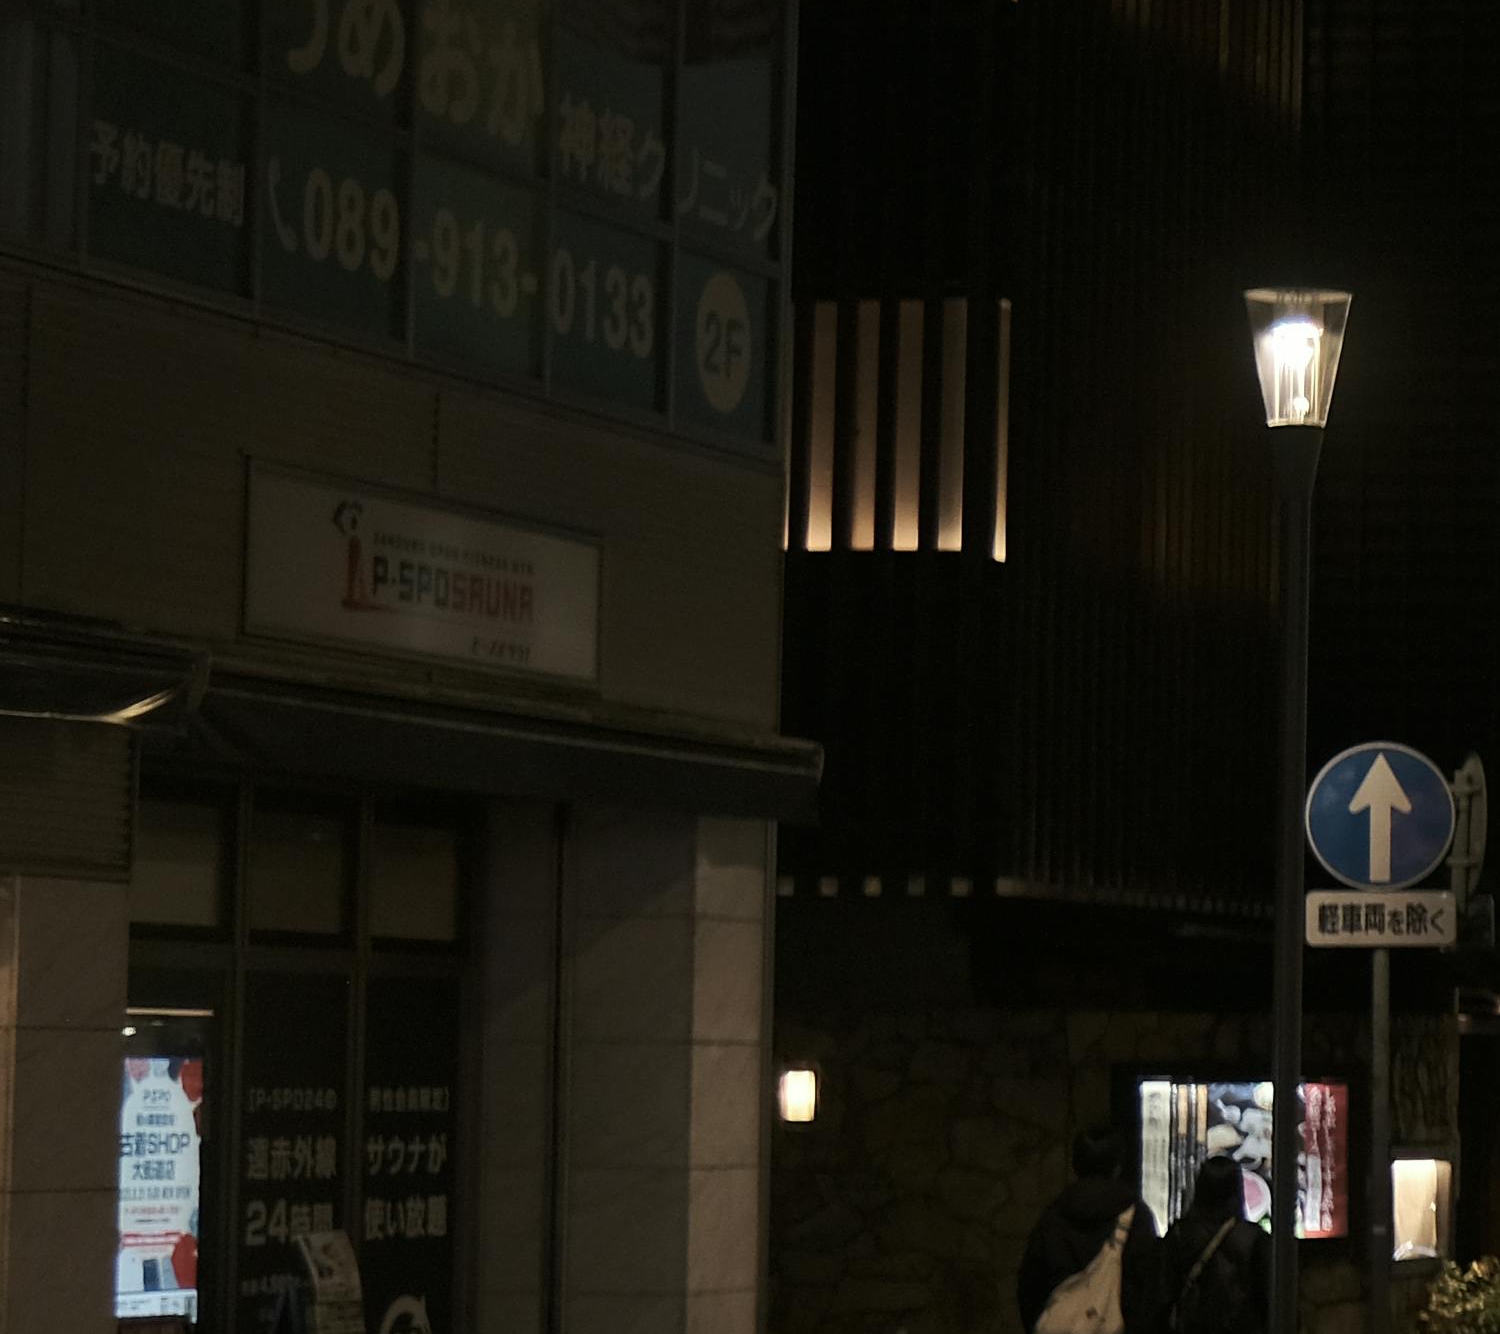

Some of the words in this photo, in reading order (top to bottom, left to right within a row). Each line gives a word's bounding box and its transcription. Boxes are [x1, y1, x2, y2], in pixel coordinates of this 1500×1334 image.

[1318, 901, 1445, 936] 軽車両を除く
